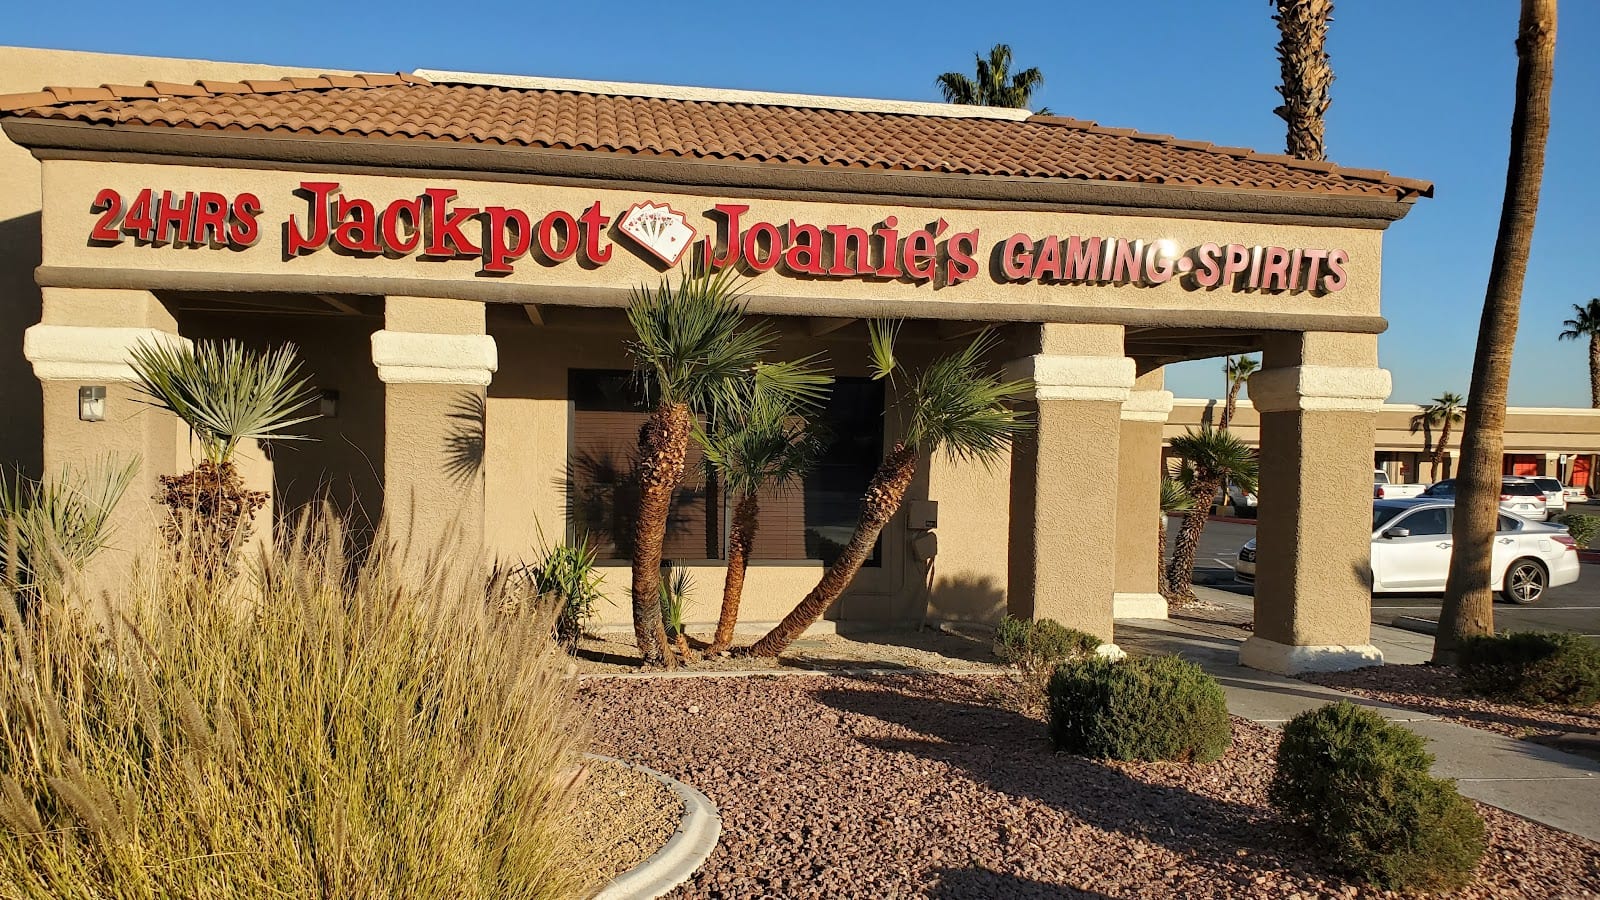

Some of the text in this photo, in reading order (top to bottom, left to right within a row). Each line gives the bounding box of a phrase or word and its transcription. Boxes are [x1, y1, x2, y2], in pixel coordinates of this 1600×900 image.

[92, 181, 1350, 292] 24HRS Jackpot Joanie's GAMING SPIRITS
